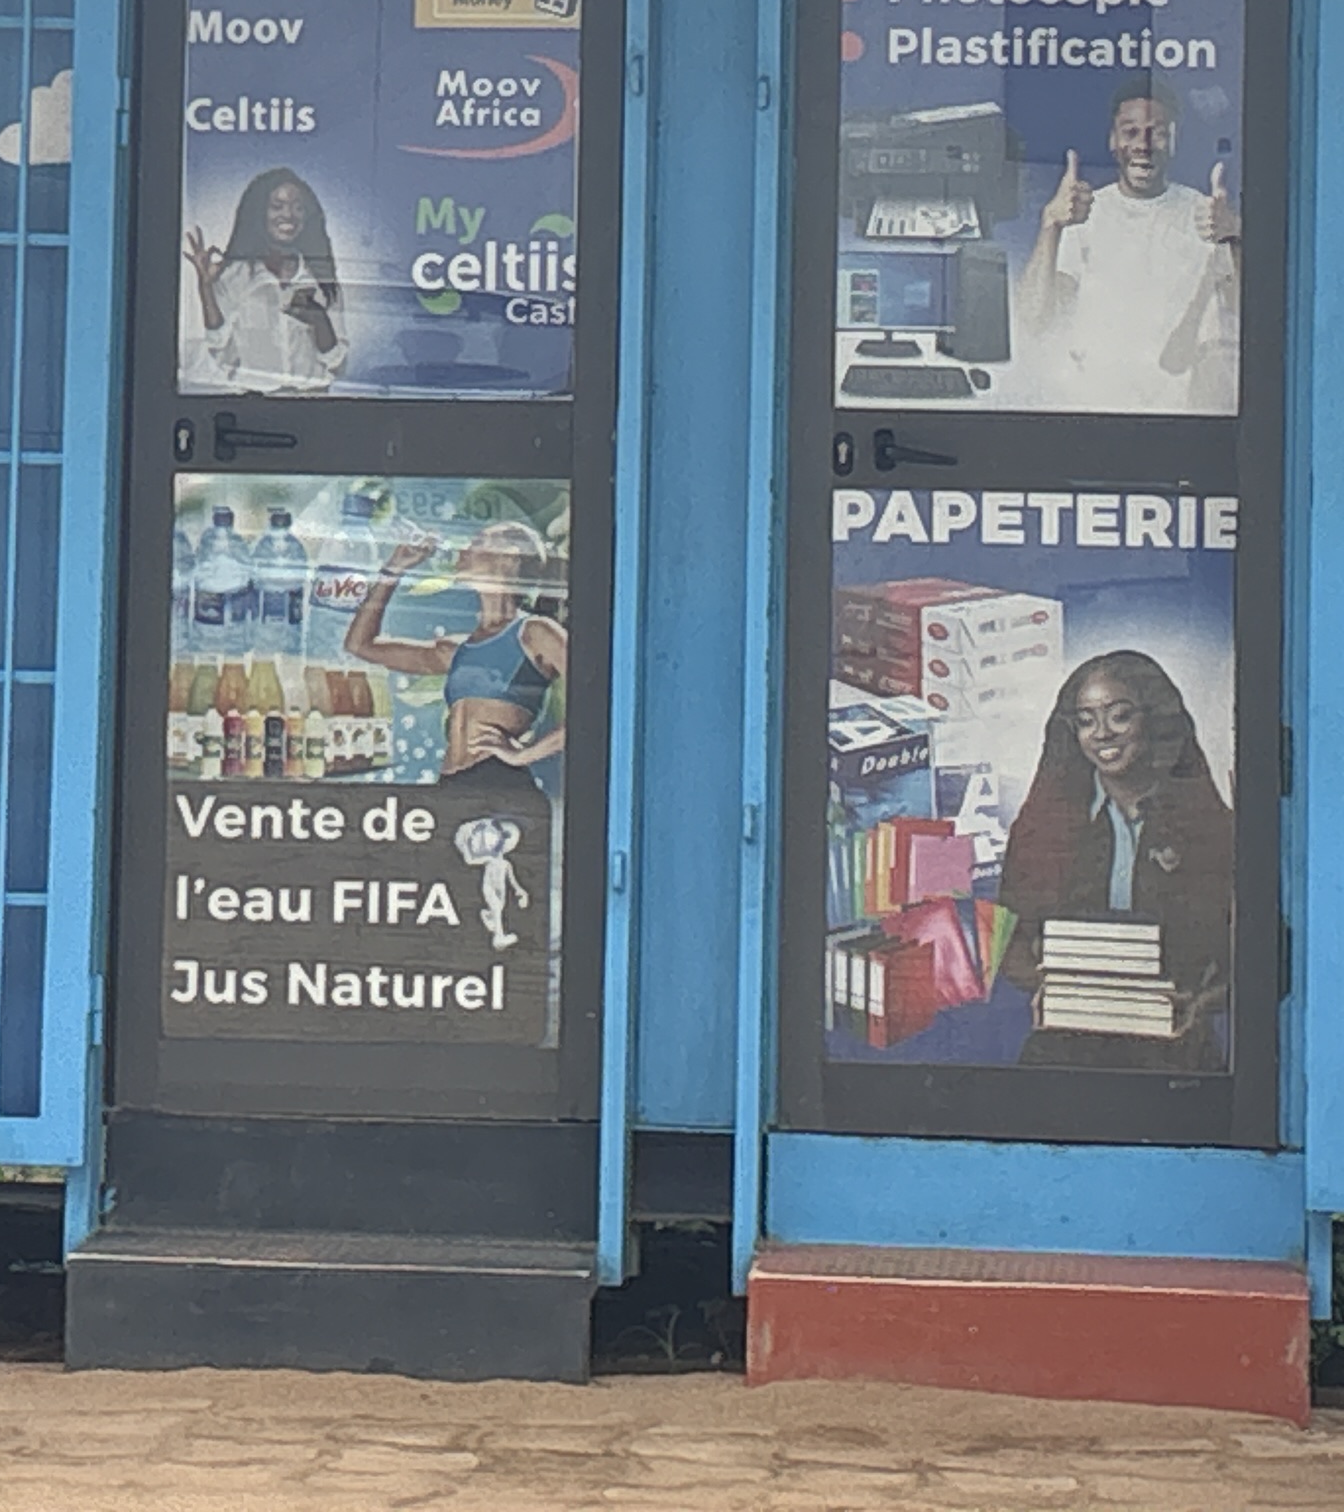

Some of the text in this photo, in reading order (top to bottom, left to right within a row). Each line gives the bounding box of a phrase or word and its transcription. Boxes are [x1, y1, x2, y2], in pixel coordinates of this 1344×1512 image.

[188, 9, 304, 45] Moov
[887, 26, 1217, 69] Plastification
[436, 69, 542, 98] Moov
[185, 96, 317, 134] Celtiis
[435, 99, 542, 128] Africa
[415, 196, 486, 243] My
[831, 489, 1239, 550] PAPETERIE
[175, 794, 436, 842] Vente de
[175, 874, 461, 926] l’eau FIFA
[170, 959, 505, 1011] Jus Naturel
